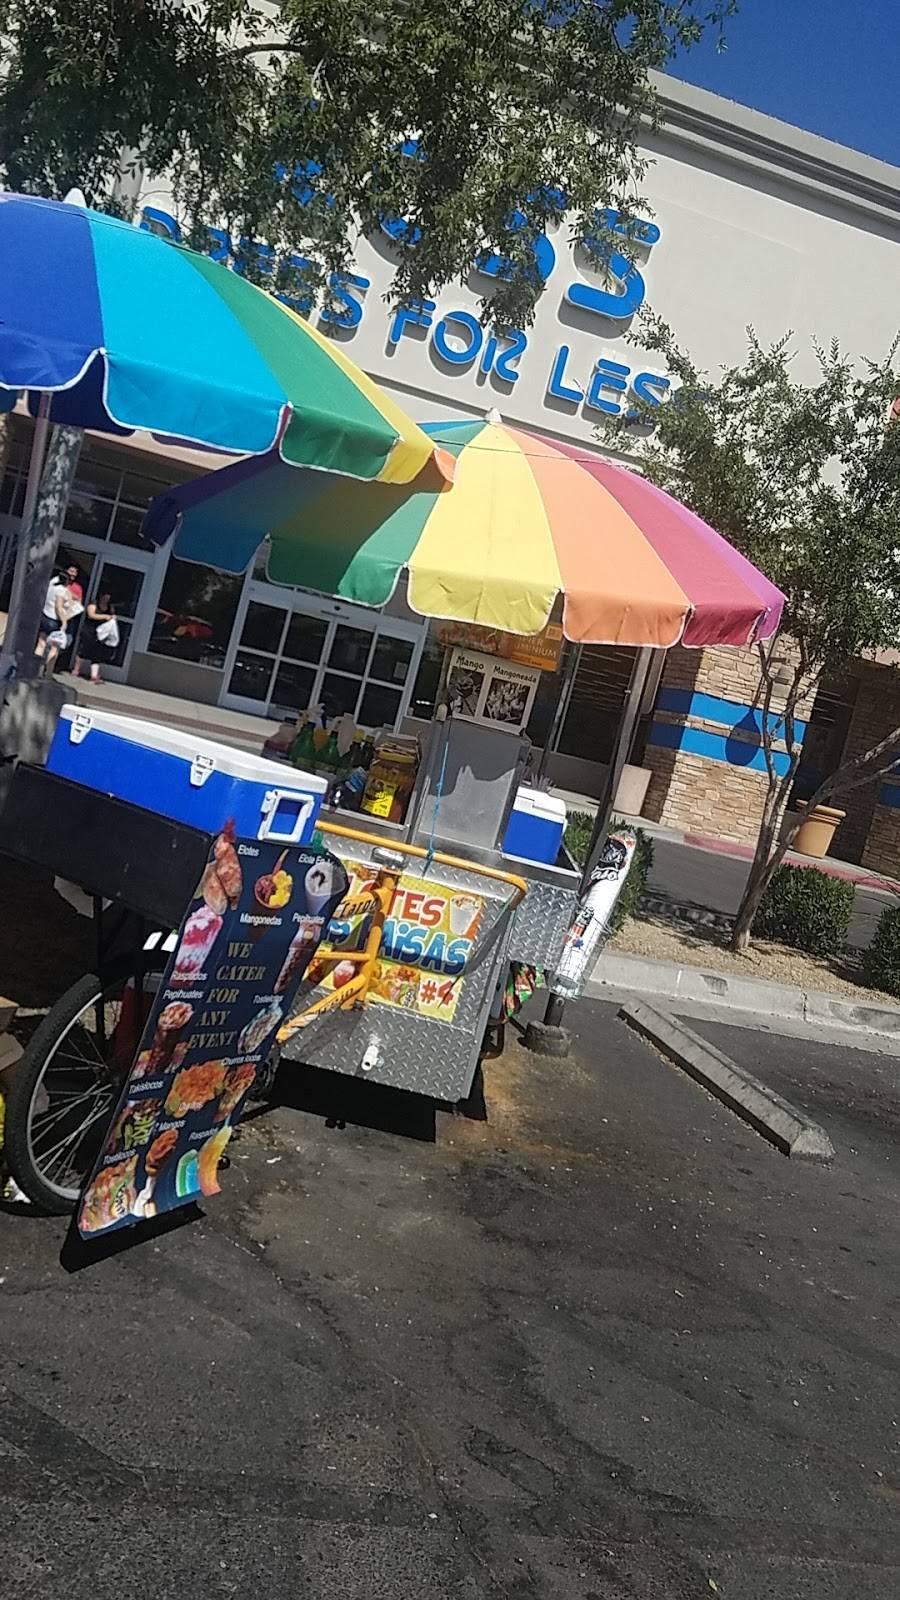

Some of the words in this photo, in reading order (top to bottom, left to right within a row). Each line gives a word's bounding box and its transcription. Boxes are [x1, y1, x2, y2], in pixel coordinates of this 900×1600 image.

[389, 298, 527, 381] FOR
[550, 345, 706, 420] LES
[456, 655, 485, 673] Mango
[227, 942, 253, 958] WE
[216, 966, 266, 981] CATER
[206, 988, 240, 1003] FOR
[419, 979, 455, 1007] #4
[196, 1011, 231, 1026] ANY
[188, 1031, 238, 1049] EVENT
